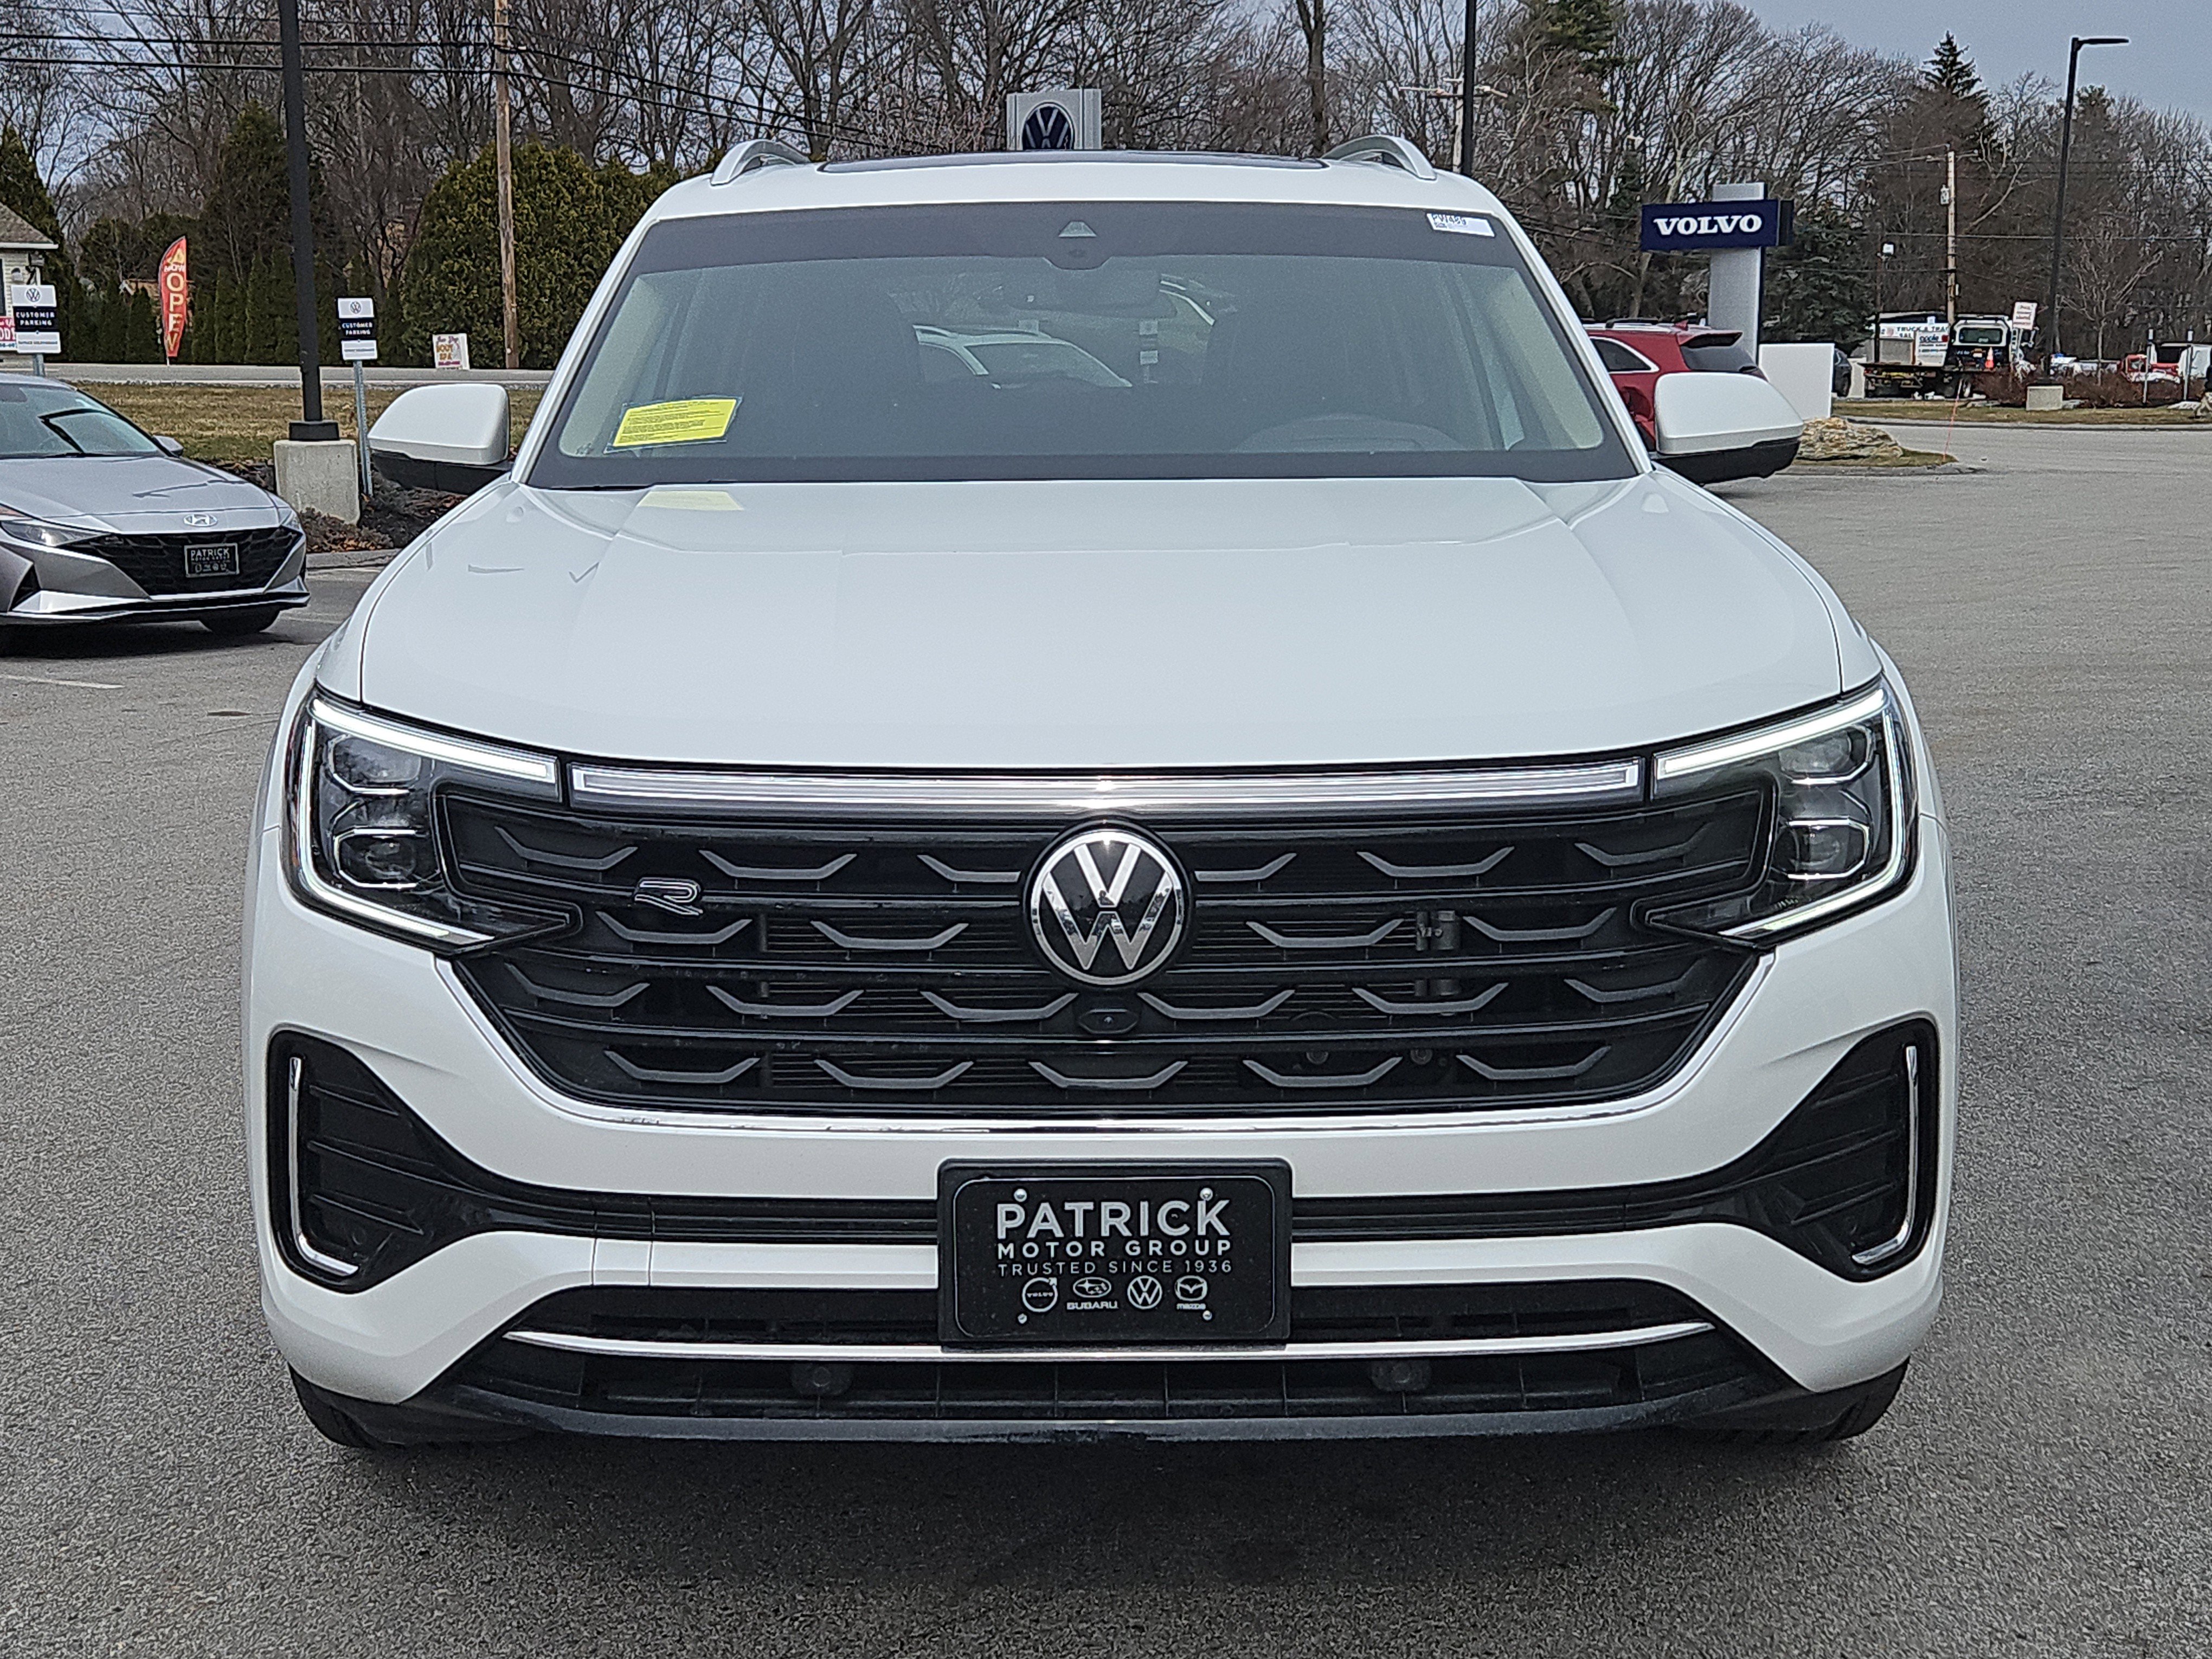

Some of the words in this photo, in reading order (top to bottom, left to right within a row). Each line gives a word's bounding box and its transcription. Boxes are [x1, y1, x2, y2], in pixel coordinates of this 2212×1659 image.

[1653, 214, 1762, 235] VOLVO
[165, 272, 185, 352] OPEN
[190, 547, 230, 561] PATRICK
[997, 1200, 1231, 1239] PATRICK
[998, 1241, 1105, 1259] MOTOR
[1125, 1239, 1231, 1256] GROUP
[998, 1262, 1096, 1277] TRUSTED
[1109, 1260, 1172, 1274] SINCE
[1185, 1259, 1231, 1273] 1936
[1066, 1301, 1119, 1310] SUBARU
